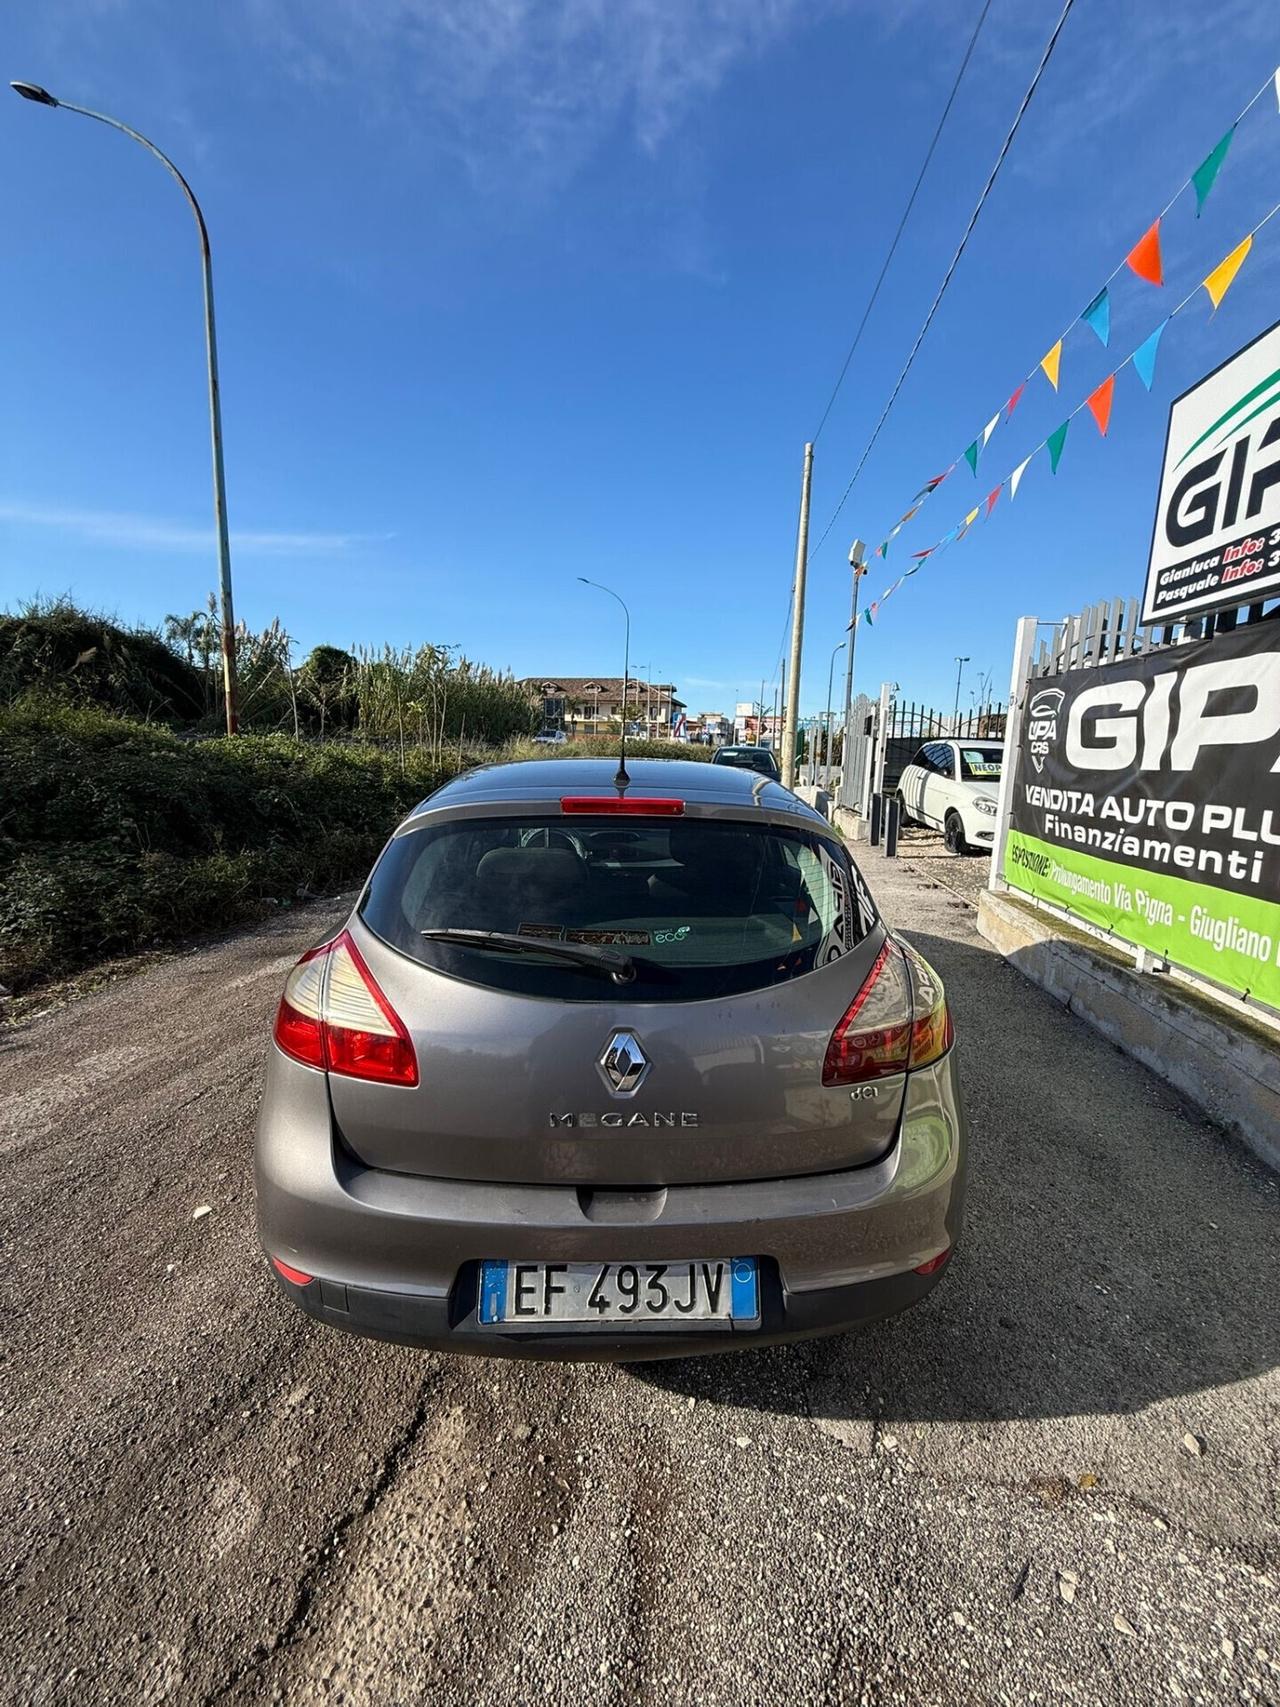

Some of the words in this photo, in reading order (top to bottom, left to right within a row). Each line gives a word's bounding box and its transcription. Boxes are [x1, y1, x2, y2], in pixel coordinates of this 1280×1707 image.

[1156, 574, 1219, 604] Pasquale
[1221, 559, 1264, 584] Info:
[1159, 556, 1220, 586] Gianluca
[1222, 538, 1265, 564] Info:
[1066, 652, 1280, 772] GIP
[1025, 784, 1095, 817] VENDITA
[1100, 796, 1195, 831] AUTO
[1045, 814, 1264, 884] Finanziamenti
[655, 930, 686, 944] eco
[1114, 882, 1132, 913] Via
[1135, 888, 1173, 927] Pigna
[1190, 905, 1272, 962] Giugliano
[550, 1112, 699, 1128] MEGANE
[514, 1264, 568, 1315] EF
